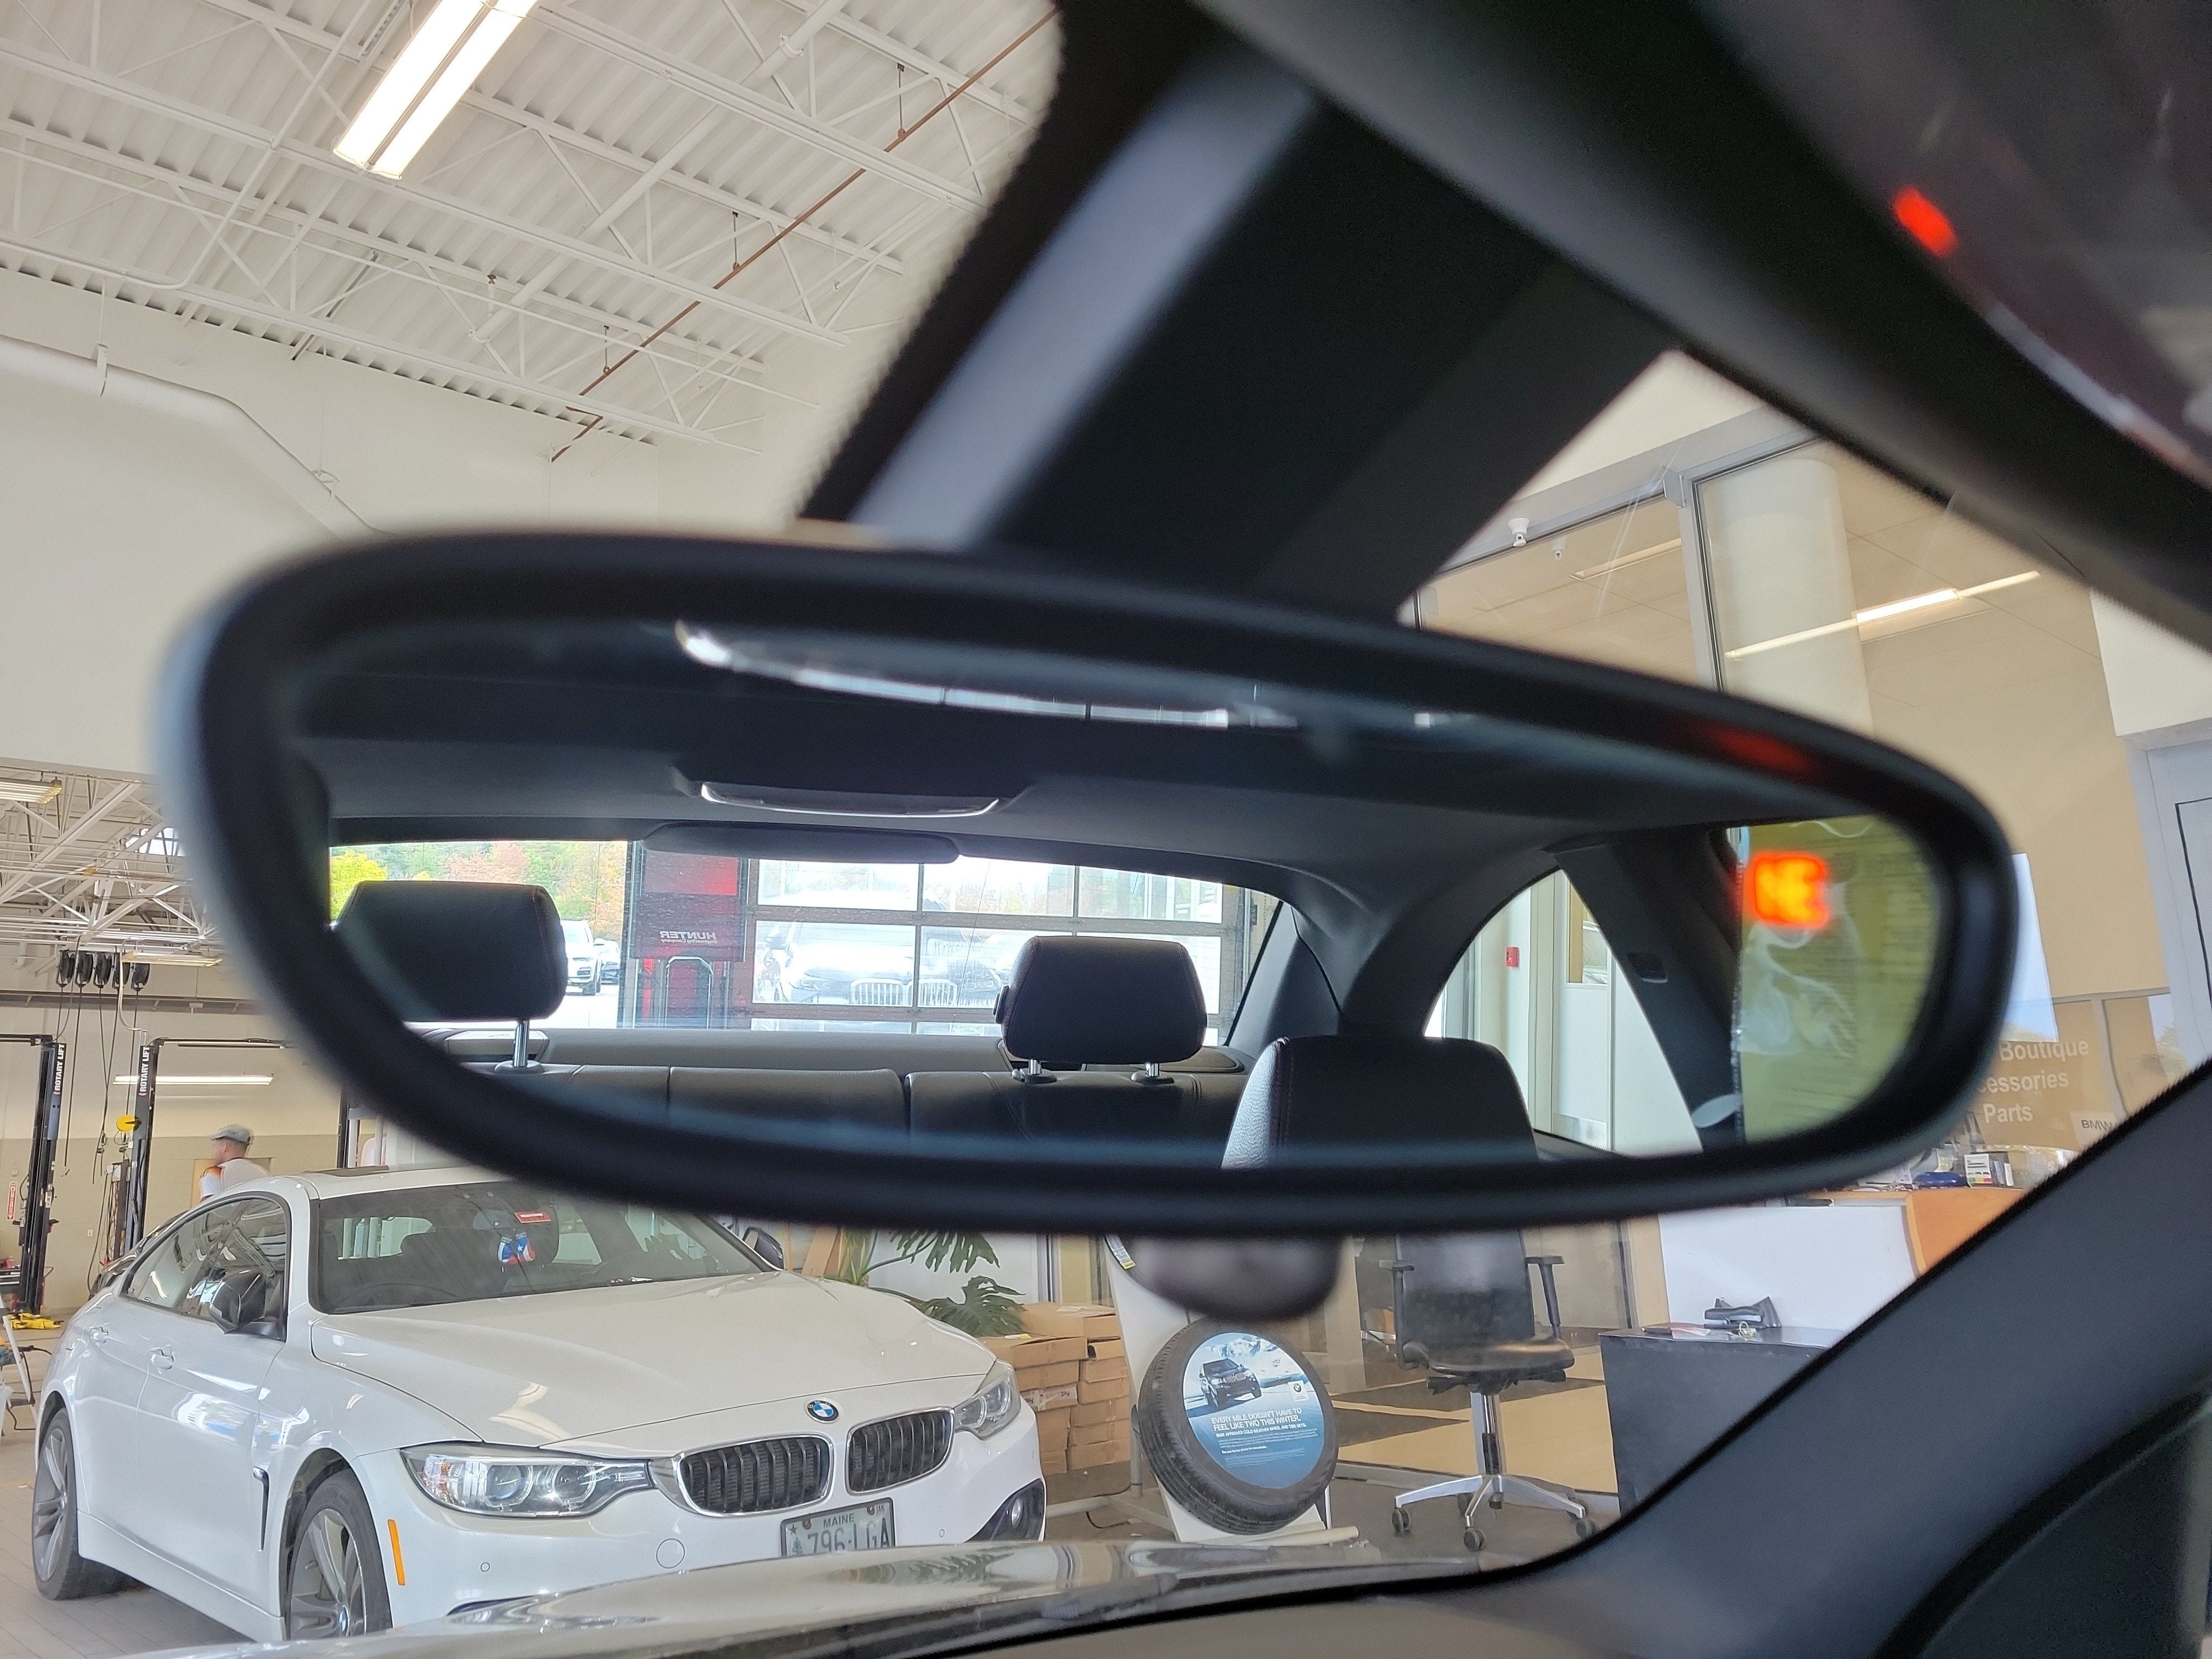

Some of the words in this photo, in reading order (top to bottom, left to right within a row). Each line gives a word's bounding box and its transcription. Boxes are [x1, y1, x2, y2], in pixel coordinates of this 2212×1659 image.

[2000, 1040, 2089, 1062] Boutique
[54, 1060, 63, 1091] ROTARY
[139, 1063, 149, 1092] ROTARY
[1983, 1102, 2033, 1124] Parts
[1211, 1415, 1231, 1424] EVERY
[1232, 1413, 1247, 1421] MILE
[1248, 1410, 1274, 1420] DOESN'T
[1276, 1409, 1293, 1417] HAVE
[1213, 1423, 1230, 1431] FEEL
[1229, 1421, 1244, 1429] LIKE
[1244, 1419, 1260, 1427] TWO
[1259, 1418, 1276, 1426] THIS
[1276, 1414, 1301, 1424] WINTER.
[823, 1512, 855, 1529] MAINE
